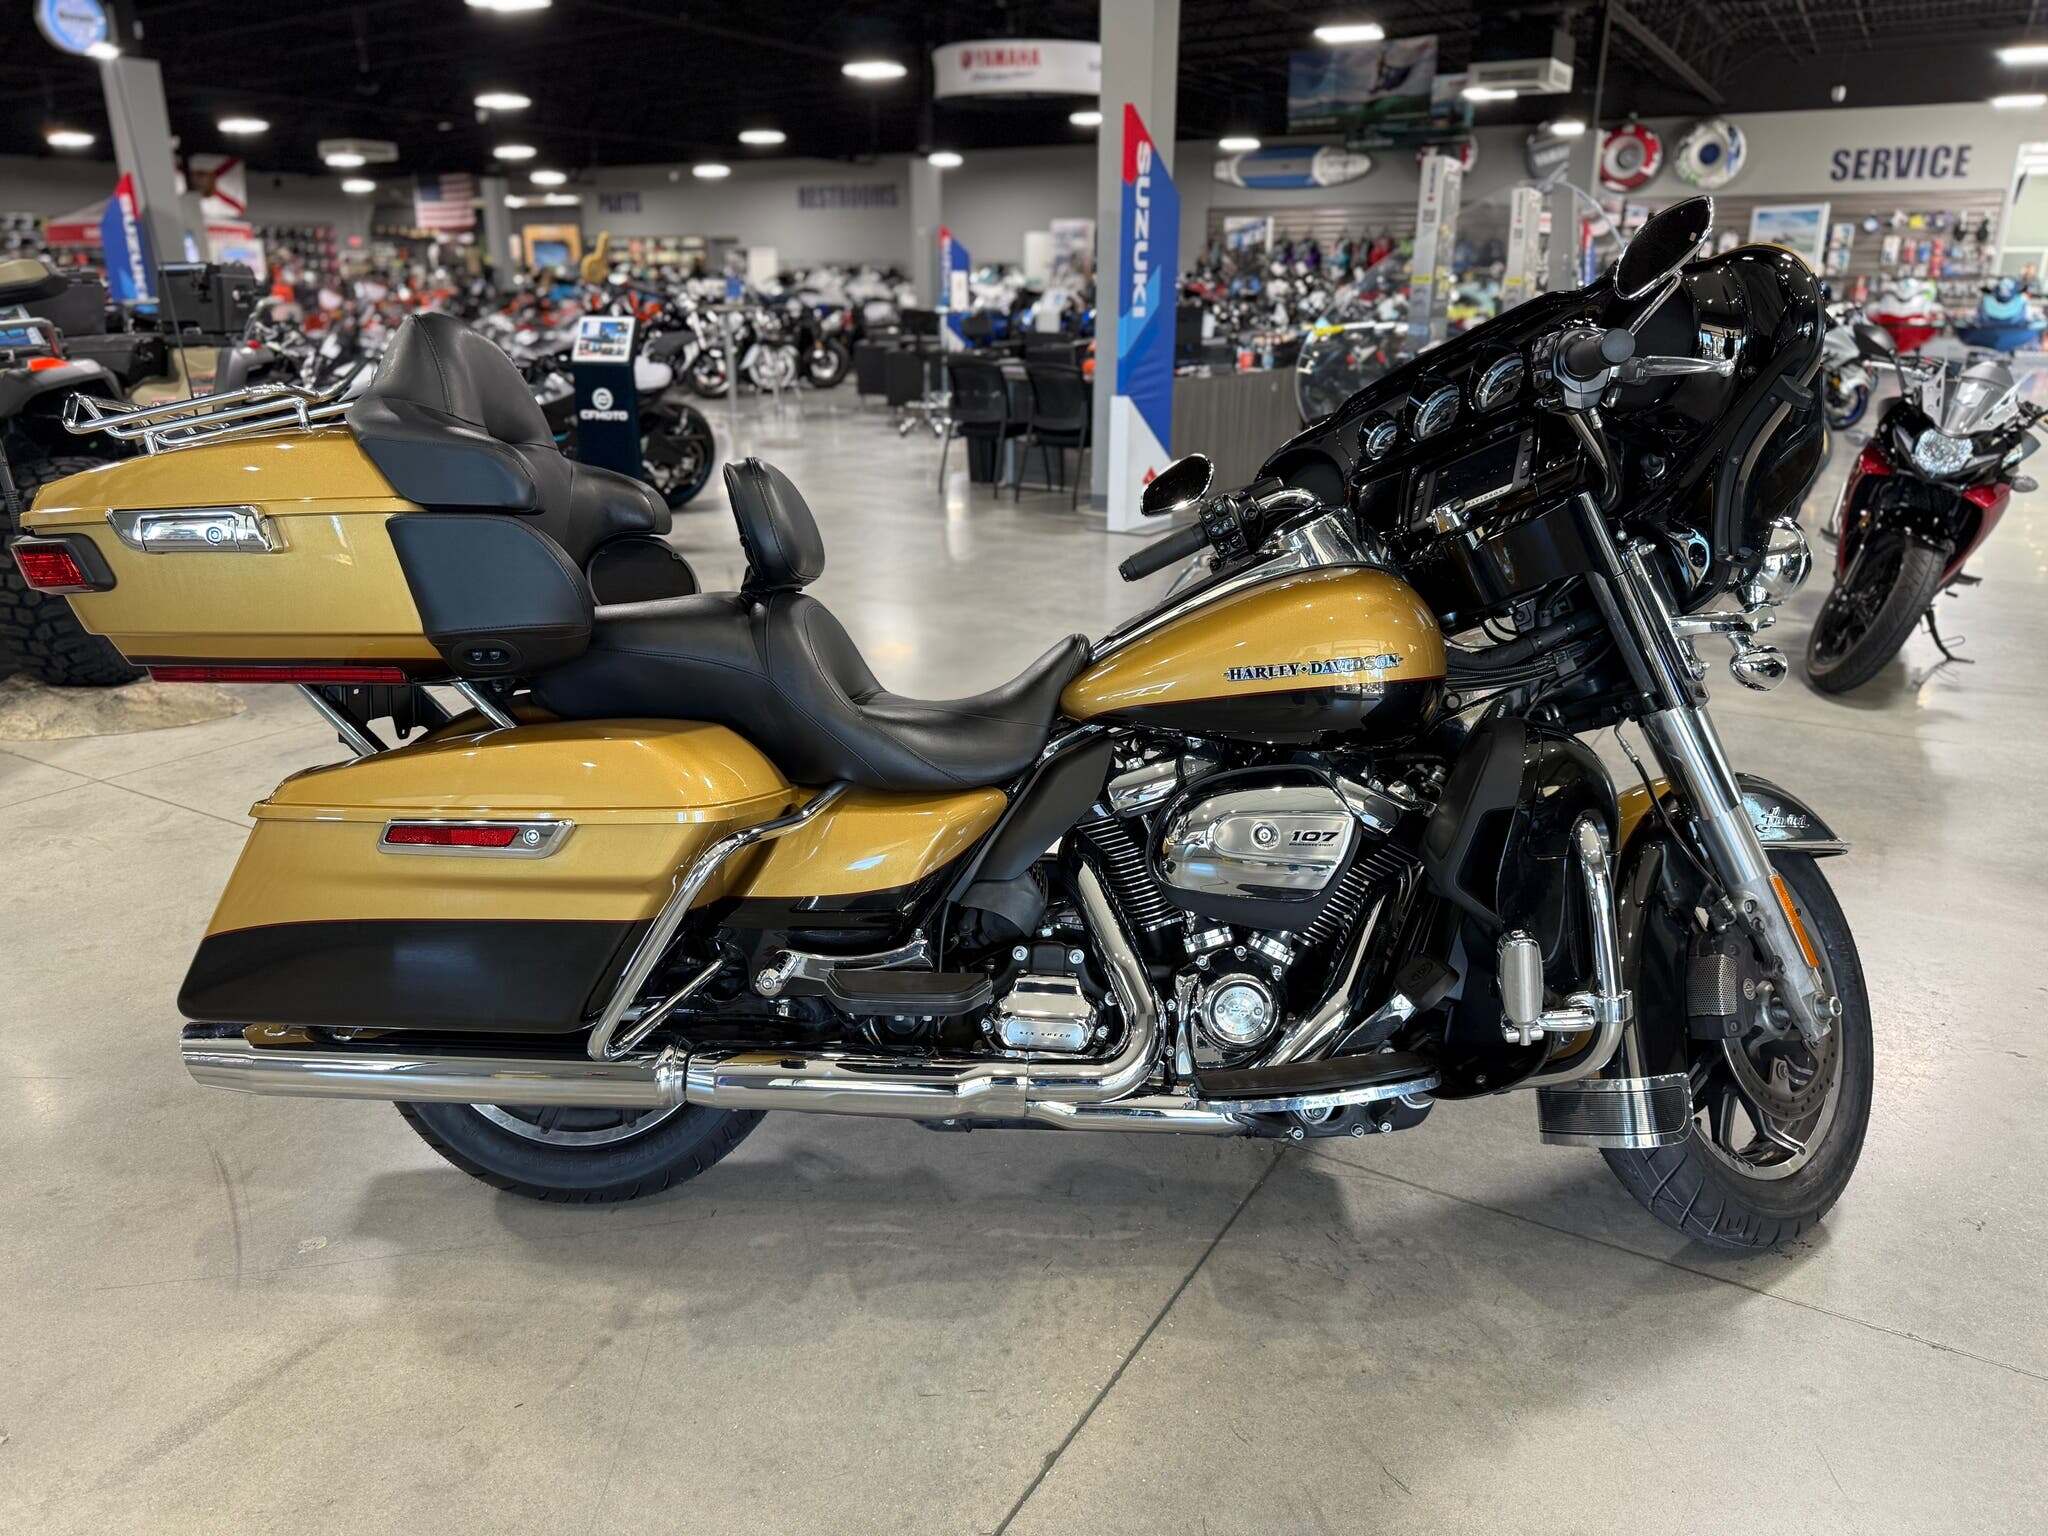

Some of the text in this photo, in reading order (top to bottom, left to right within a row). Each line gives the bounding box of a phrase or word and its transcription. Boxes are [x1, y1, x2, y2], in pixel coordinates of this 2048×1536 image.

[1830, 145, 1971, 181] SERVICE
[1132, 140, 1153, 318] SUZUKI
[579, 409, 629, 421] CFMOTO
[1292, 831, 1340, 842] 107
